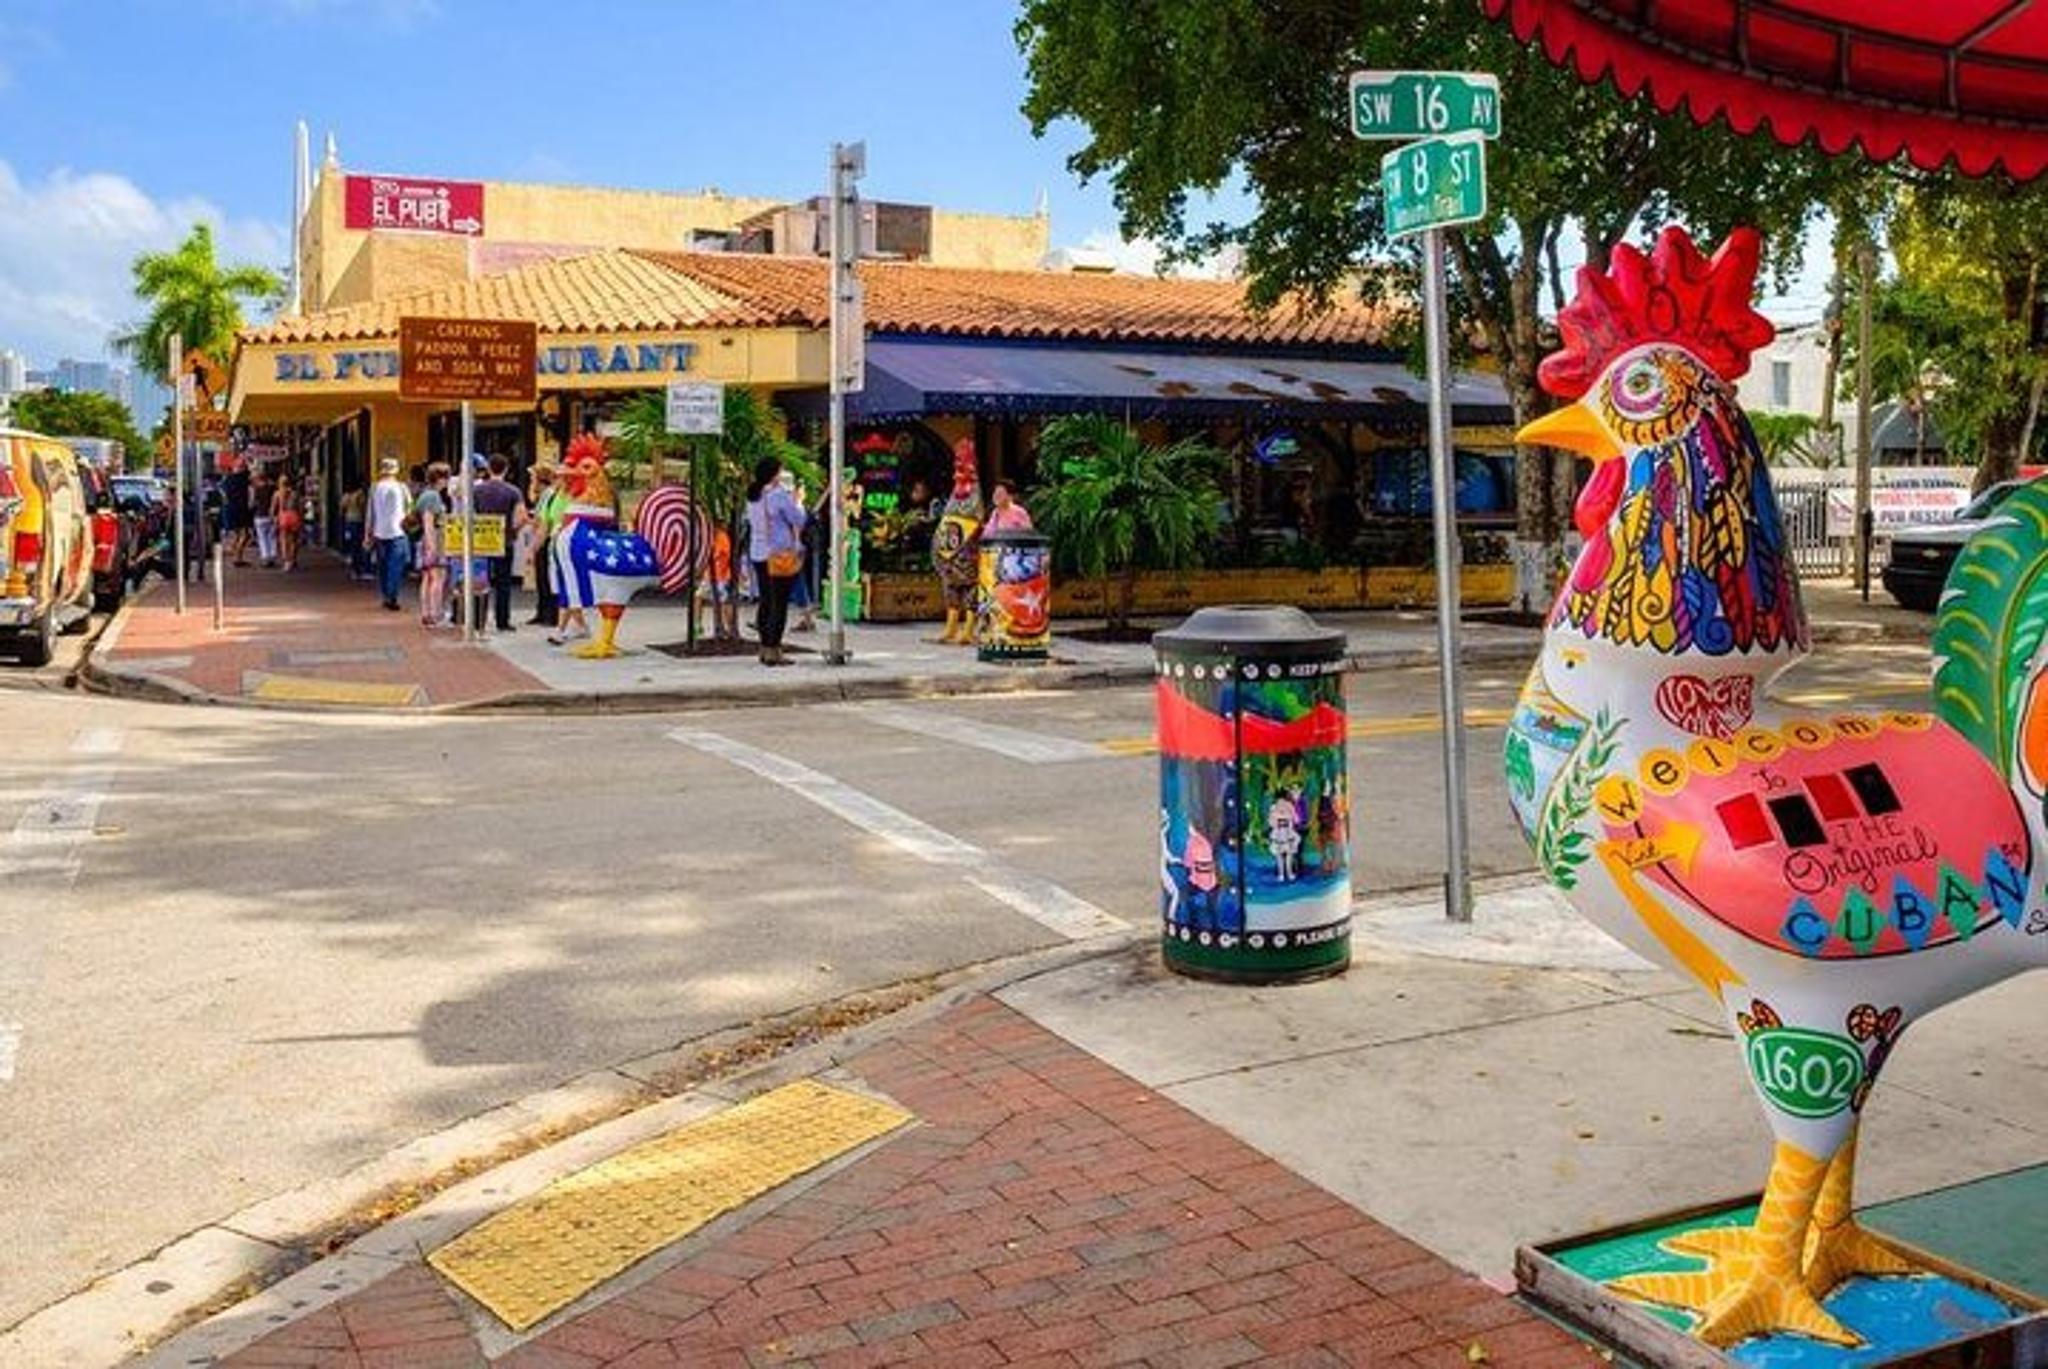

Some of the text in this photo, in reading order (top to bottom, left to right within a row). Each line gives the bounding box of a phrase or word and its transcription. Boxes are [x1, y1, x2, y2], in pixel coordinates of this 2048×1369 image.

[1359, 84, 1493, 131] SW 16 AV
[1413, 149, 1430, 195] 8
[1450, 151, 1472, 185] ST
[373, 196, 396, 220] EL
[275, 352, 320, 380] EL
[1836, 815, 1904, 843] THE
[1784, 826, 1938, 895] Original
[1786, 857, 2025, 945] CUBAN
[1753, 1040, 1856, 1100] 1602
